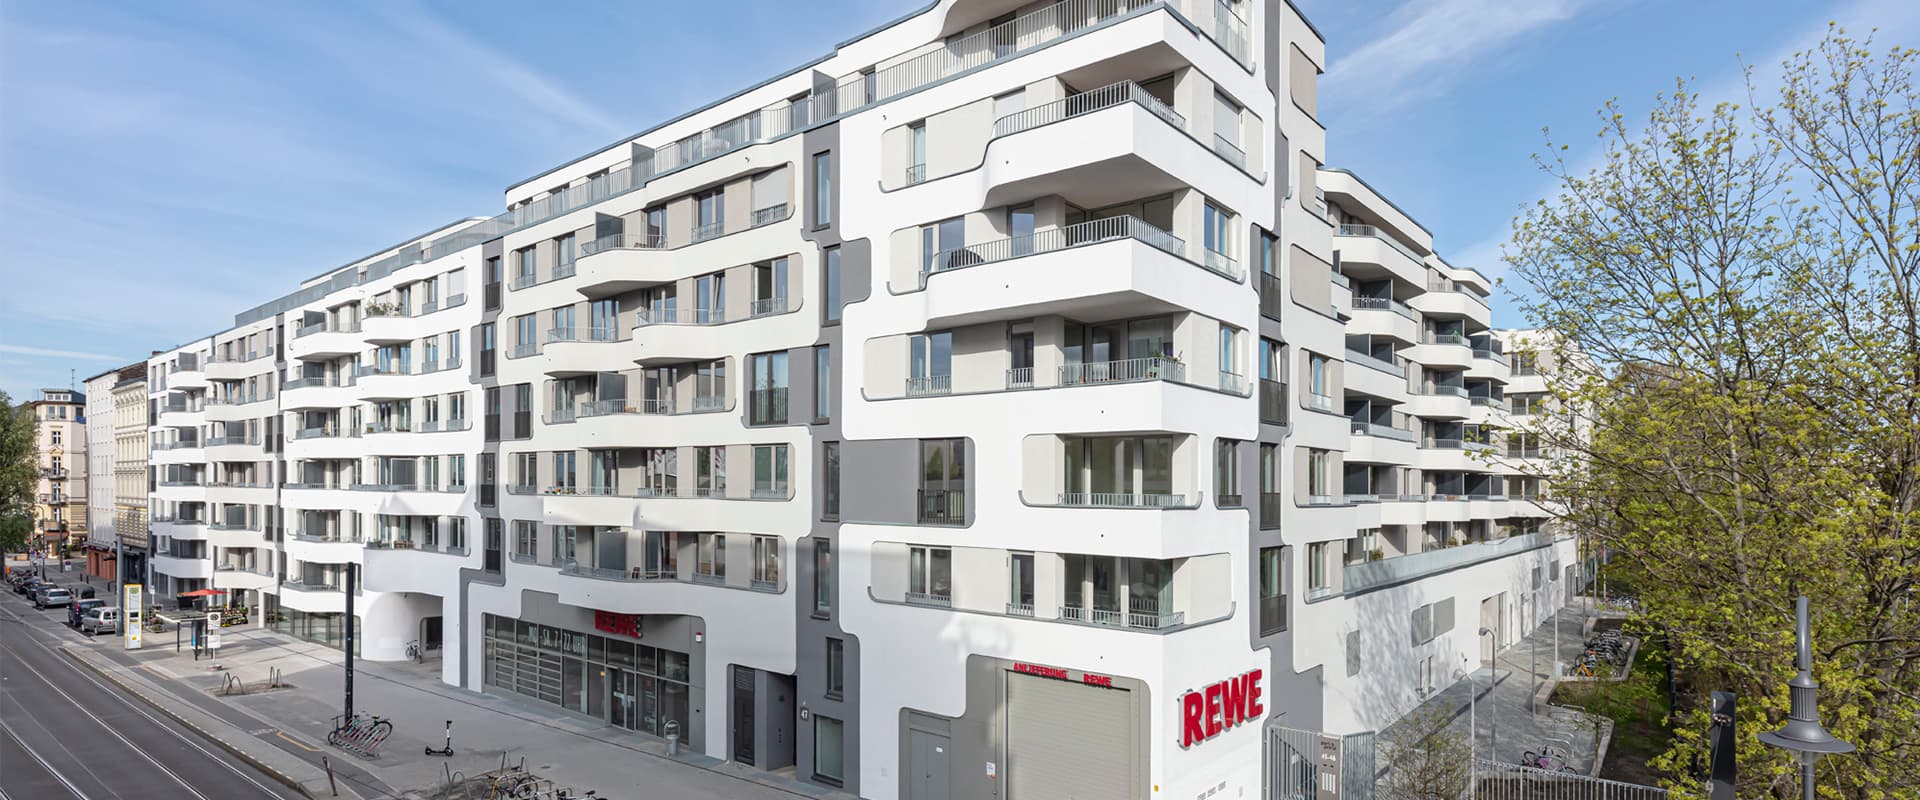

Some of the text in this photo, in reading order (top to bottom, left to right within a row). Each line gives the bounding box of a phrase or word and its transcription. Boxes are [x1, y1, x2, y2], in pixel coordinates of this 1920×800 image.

[594, 610, 640, 638] REWE
[1013, 662, 1067, 680] ANLIEFERUNG
[1083, 673, 1111, 687] REWE
[801, 709, 808, 719] 47
[1180, 668, 1264, 748] REWE
